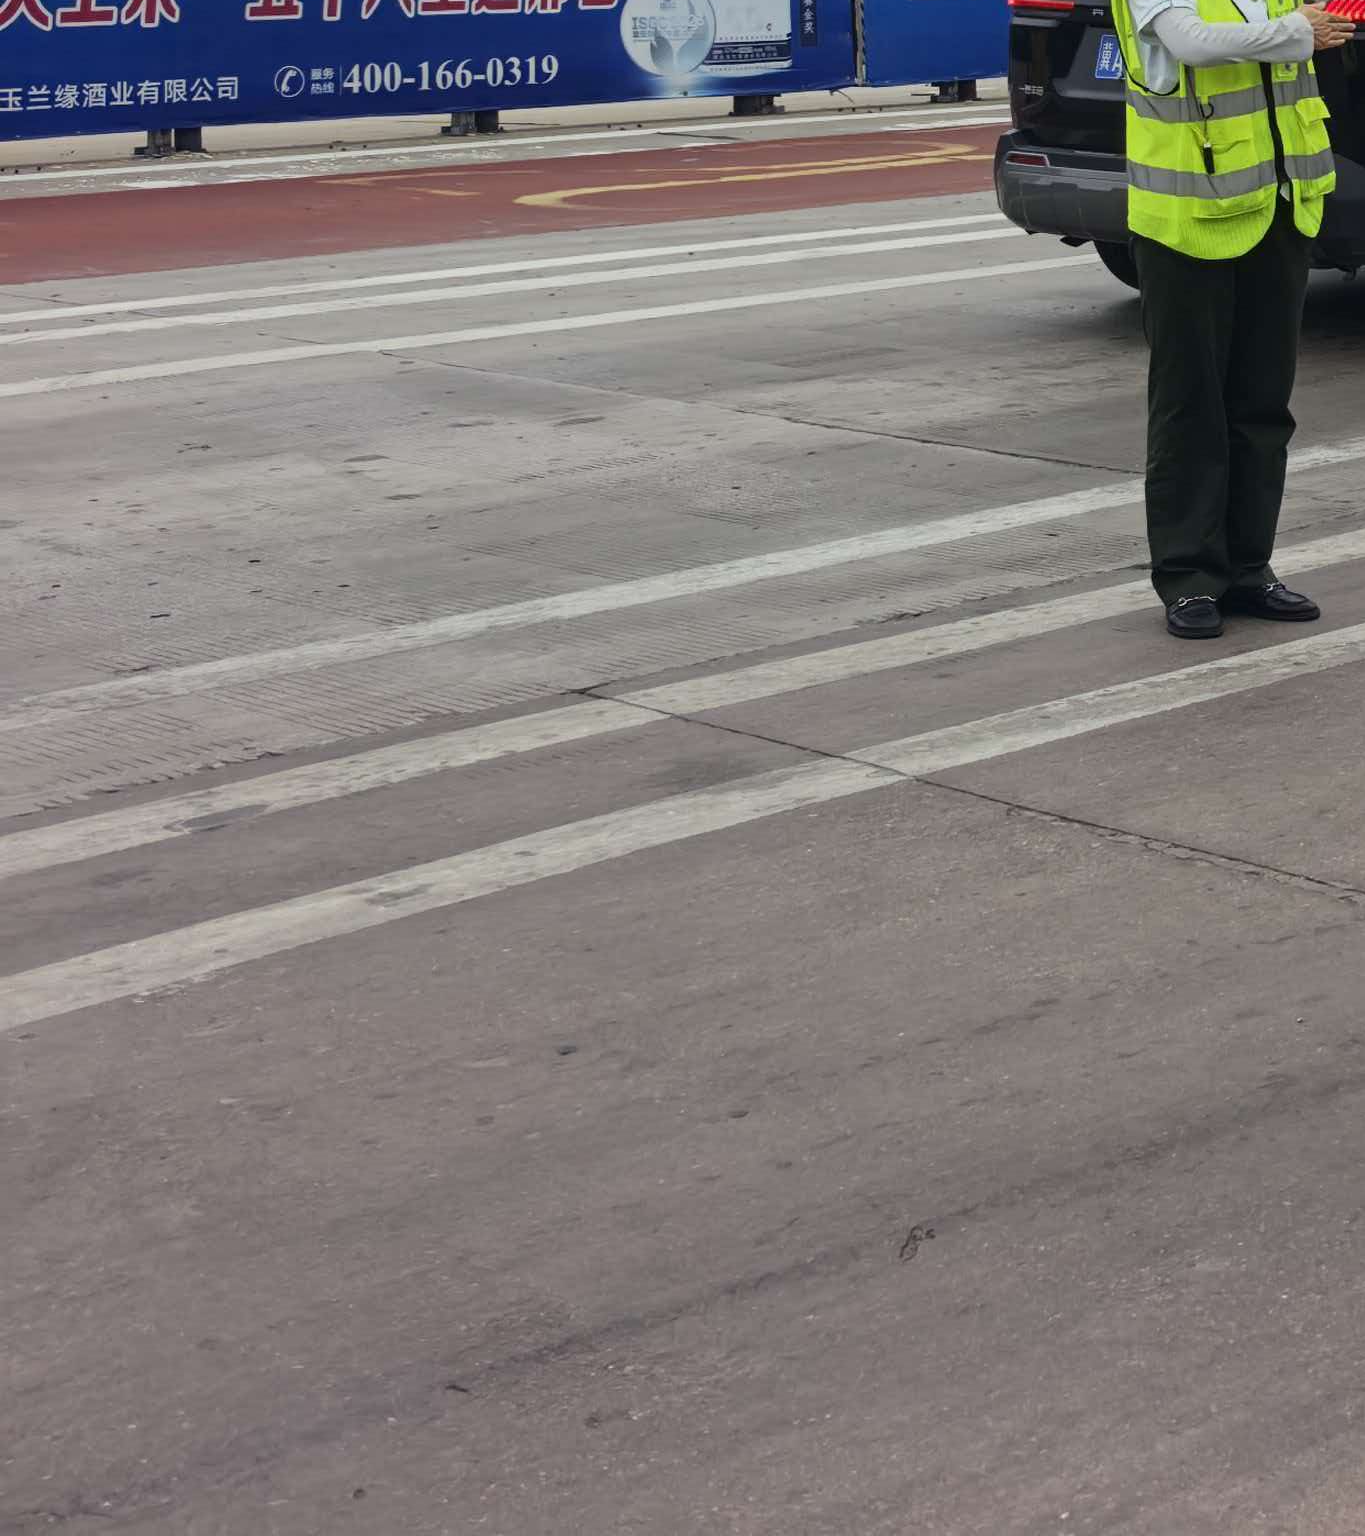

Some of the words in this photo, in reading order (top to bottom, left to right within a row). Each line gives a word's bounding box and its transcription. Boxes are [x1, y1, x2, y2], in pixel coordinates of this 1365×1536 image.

[342, 54, 560, 94] 400-166-0319
[0, 75, 240, 113] 玉兰缘酒业有限公司
